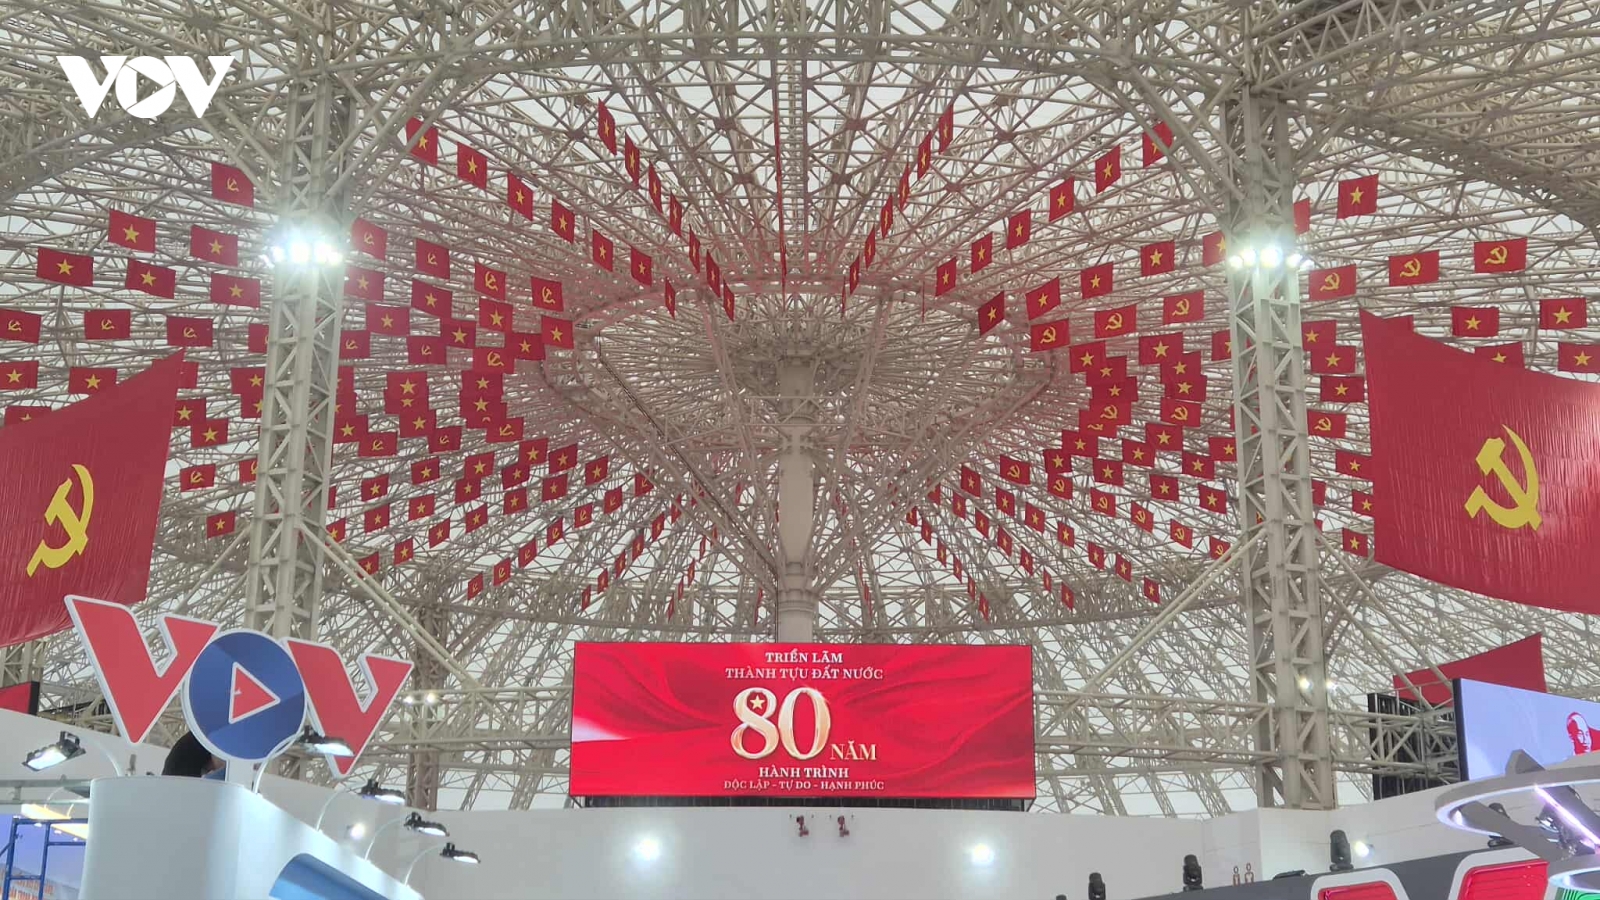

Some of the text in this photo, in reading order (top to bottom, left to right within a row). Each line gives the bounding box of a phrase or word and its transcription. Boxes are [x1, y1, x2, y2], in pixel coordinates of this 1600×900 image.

[765, 648, 843, 663] TRIỂN LÃM
[725, 665, 884, 681] THÀNH TỰU ĐẤT NƯỚC
[64, 594, 415, 779] VOV
[730, 687, 877, 761] 80 NĂM
[759, 764, 849, 778] HÀNH TRÌNH
[724, 778, 747, 791] ĐỘC
[749, 778, 771, 790] LẬP
[778, 779, 793, 790] TỰ
[795, 780, 812, 790] DO
[820, 781, 852, 792] HẠNH
[855, 778, 885, 790] PHÚC
